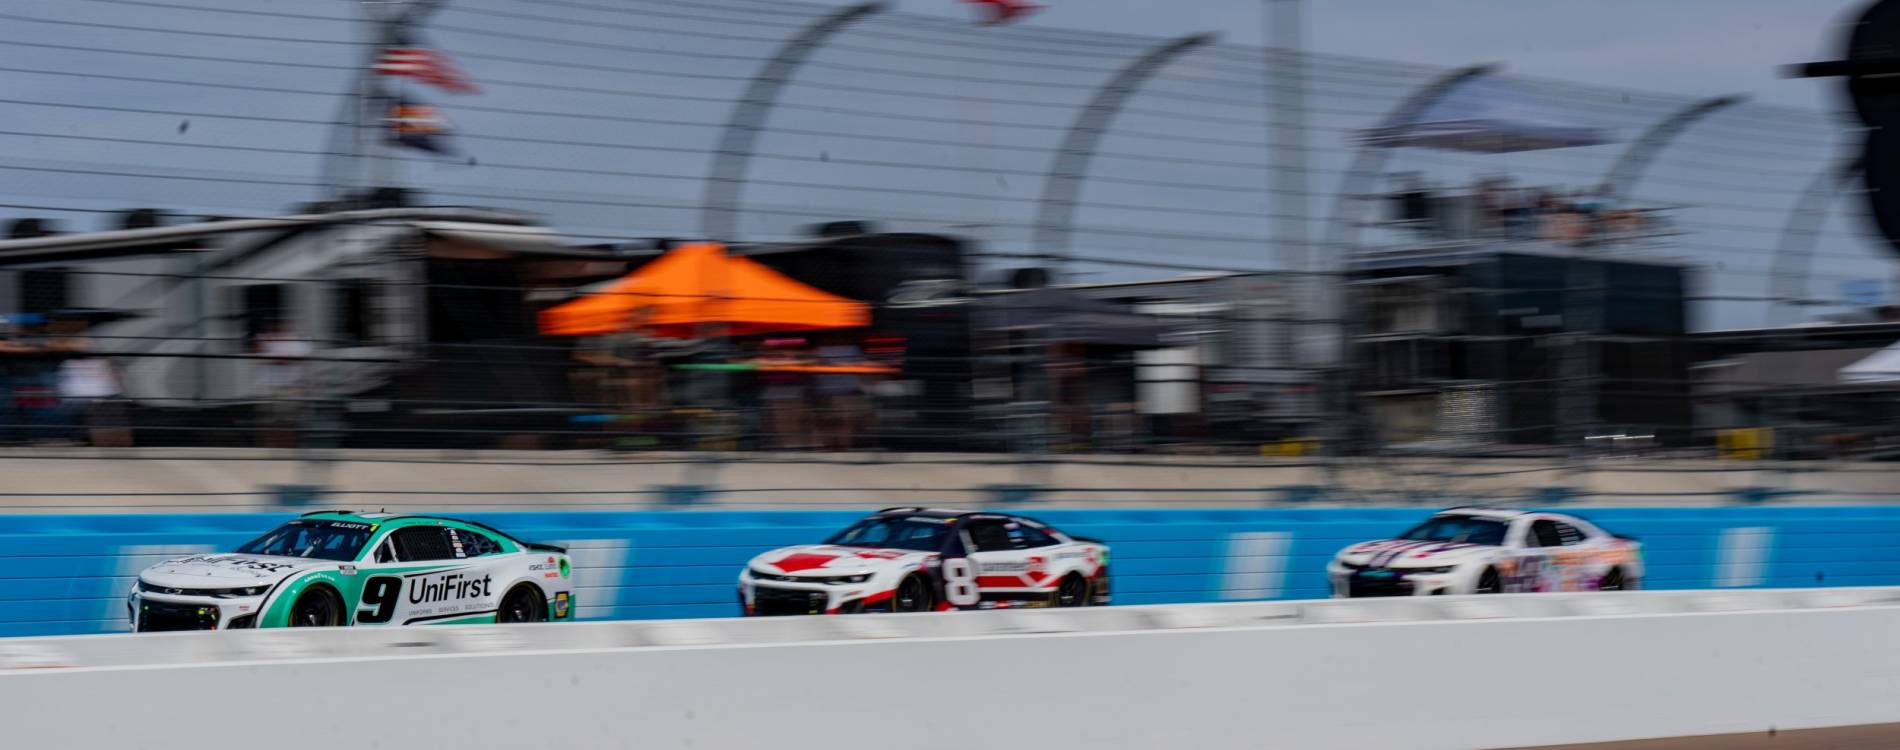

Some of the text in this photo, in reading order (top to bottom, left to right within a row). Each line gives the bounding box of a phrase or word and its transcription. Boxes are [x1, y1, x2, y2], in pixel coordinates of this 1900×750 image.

[330, 522, 369, 530] ELLIOTT
[356, 575, 403, 623] 9
[409, 573, 492, 604] UniFirst
[943, 557, 981, 606] 8
